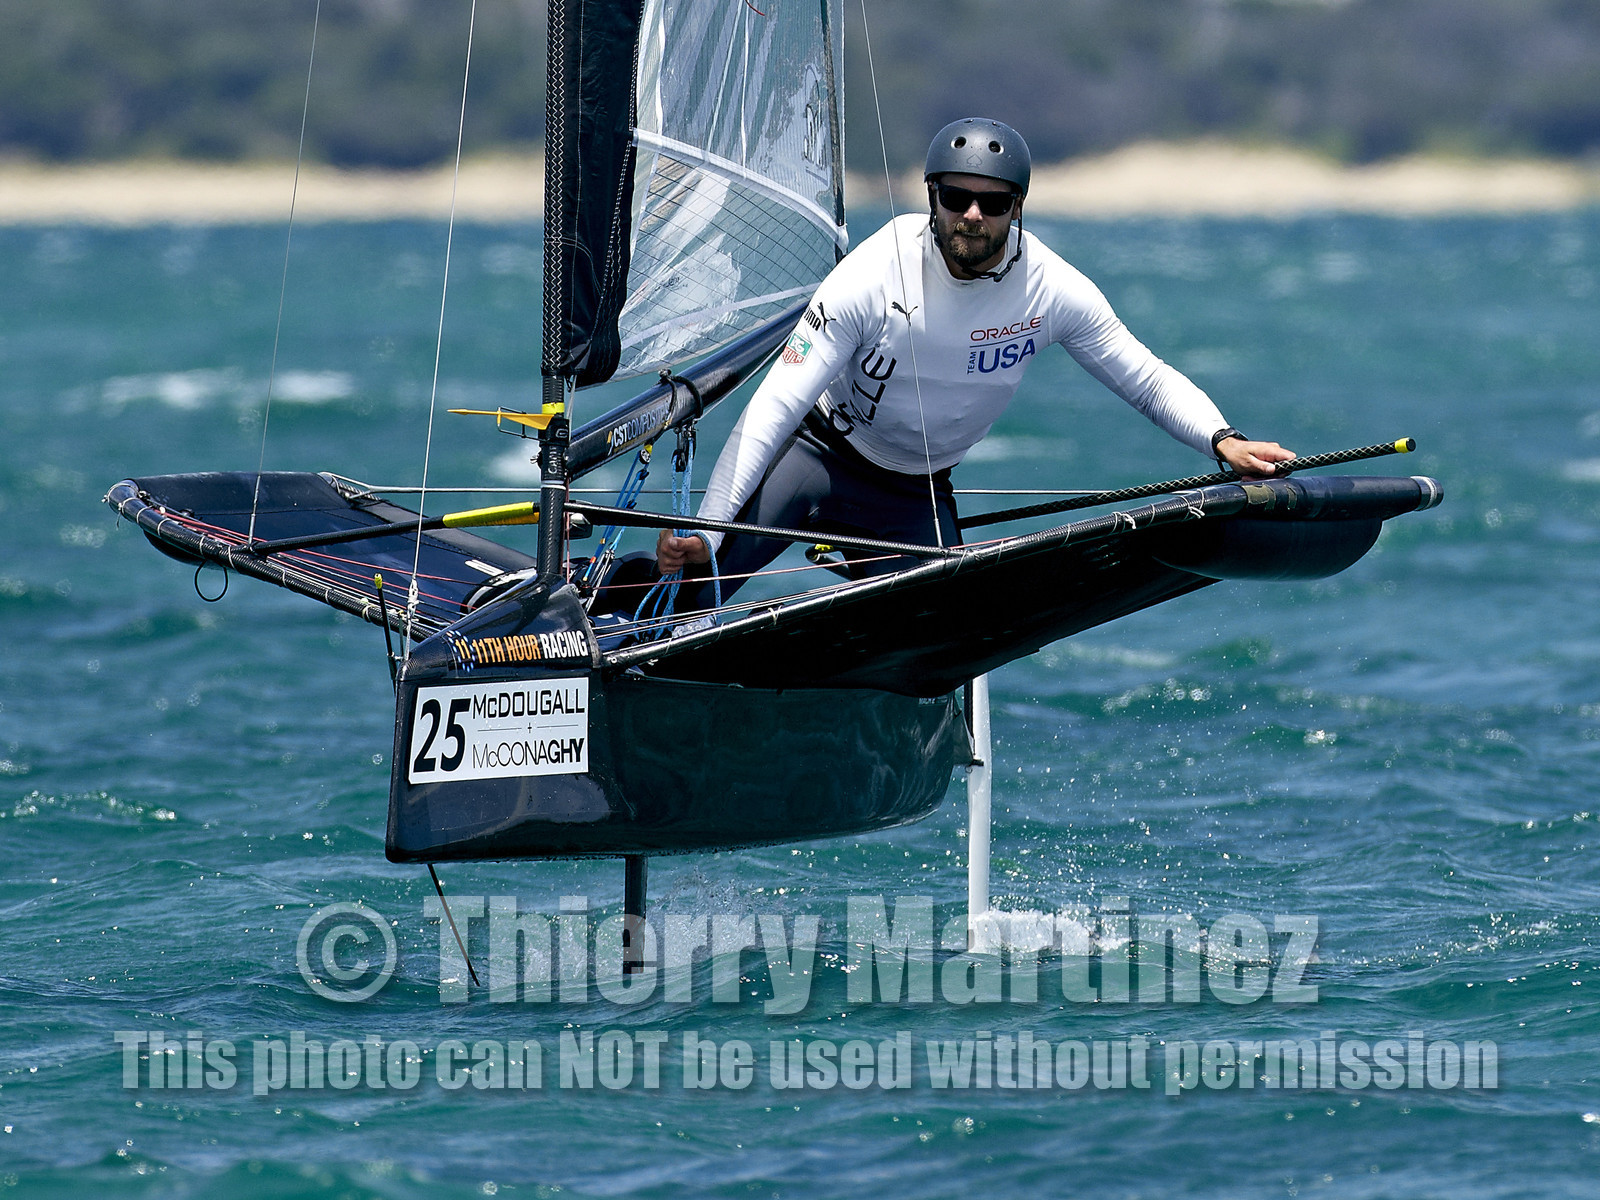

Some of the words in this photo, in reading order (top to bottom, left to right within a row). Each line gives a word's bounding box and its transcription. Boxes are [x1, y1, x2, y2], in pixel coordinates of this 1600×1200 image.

[970, 316, 1042, 341] ORACLE
[967, 351, 977, 375] TEAM
[978, 338, 1036, 373] USA
[472, 637, 506, 664] 11TH
[503, 634, 542, 662] HOUR
[539, 630, 589, 660] RACING
[472, 688, 586, 720] McDOUGALL
[412, 698, 472, 774] 25
[472, 738, 585, 769] McCONAGHY
